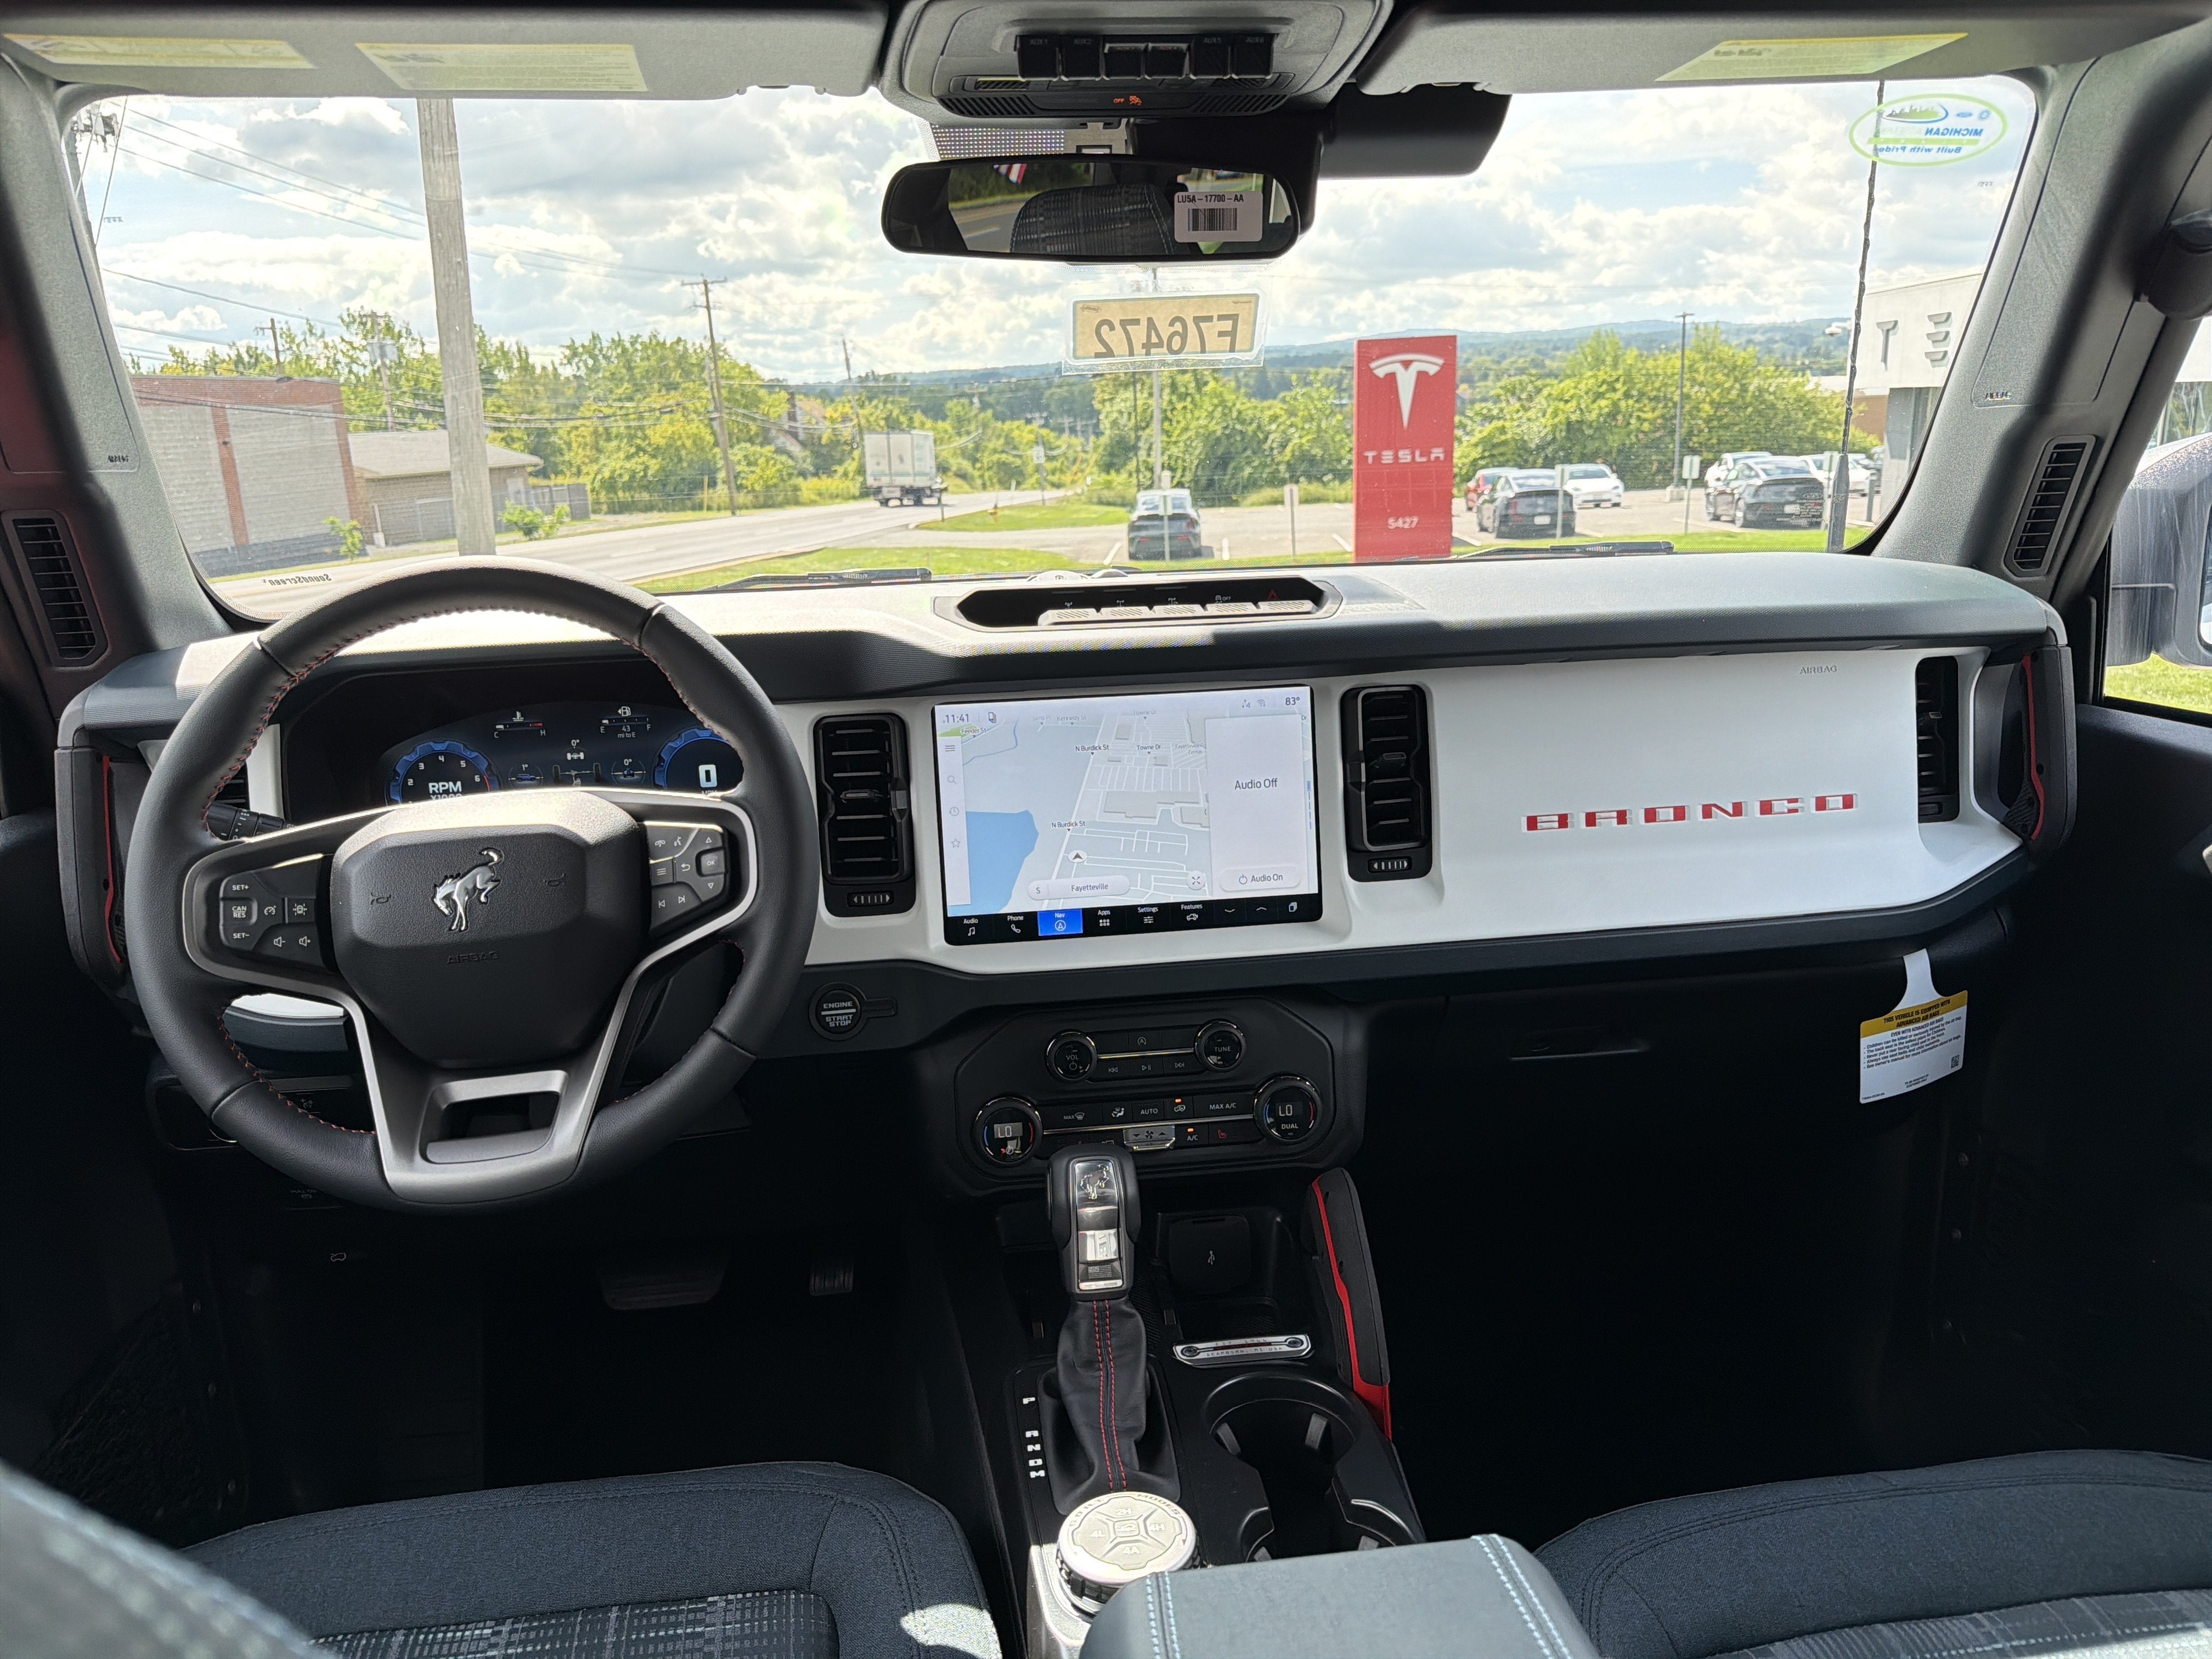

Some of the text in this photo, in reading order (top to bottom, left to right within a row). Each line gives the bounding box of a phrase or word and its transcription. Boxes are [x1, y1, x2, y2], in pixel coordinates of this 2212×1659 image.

[1363, 448, 1445, 464] TESLA
[1387, 516, 1420, 530] 5427
[1799, 665, 1837, 674] AIRBAG
[945, 713, 969, 724] 11:41
[698, 764, 718, 788] 0
[428, 781, 462, 794] RPM
[1234, 778, 1278, 790] Audio Off
[1525, 793, 1855, 832] BRONCO
[1251, 874, 1271, 883] Audio
[1071, 883, 1109, 892] Fayetteville
[823, 1001, 853, 1009] ENGINE
[1895, 1011, 1914, 1021] VEHICLE
[1940, 998, 1951, 1007] WITH
[1896, 1017, 1921, 1028] ADVANCED
[1030, 1470, 1045, 1478] M
[1137, 1493, 1181, 1515] MODES
[1115, 1507, 1132, 1516] 2H
[1122, 1546, 1141, 1555] 4A
